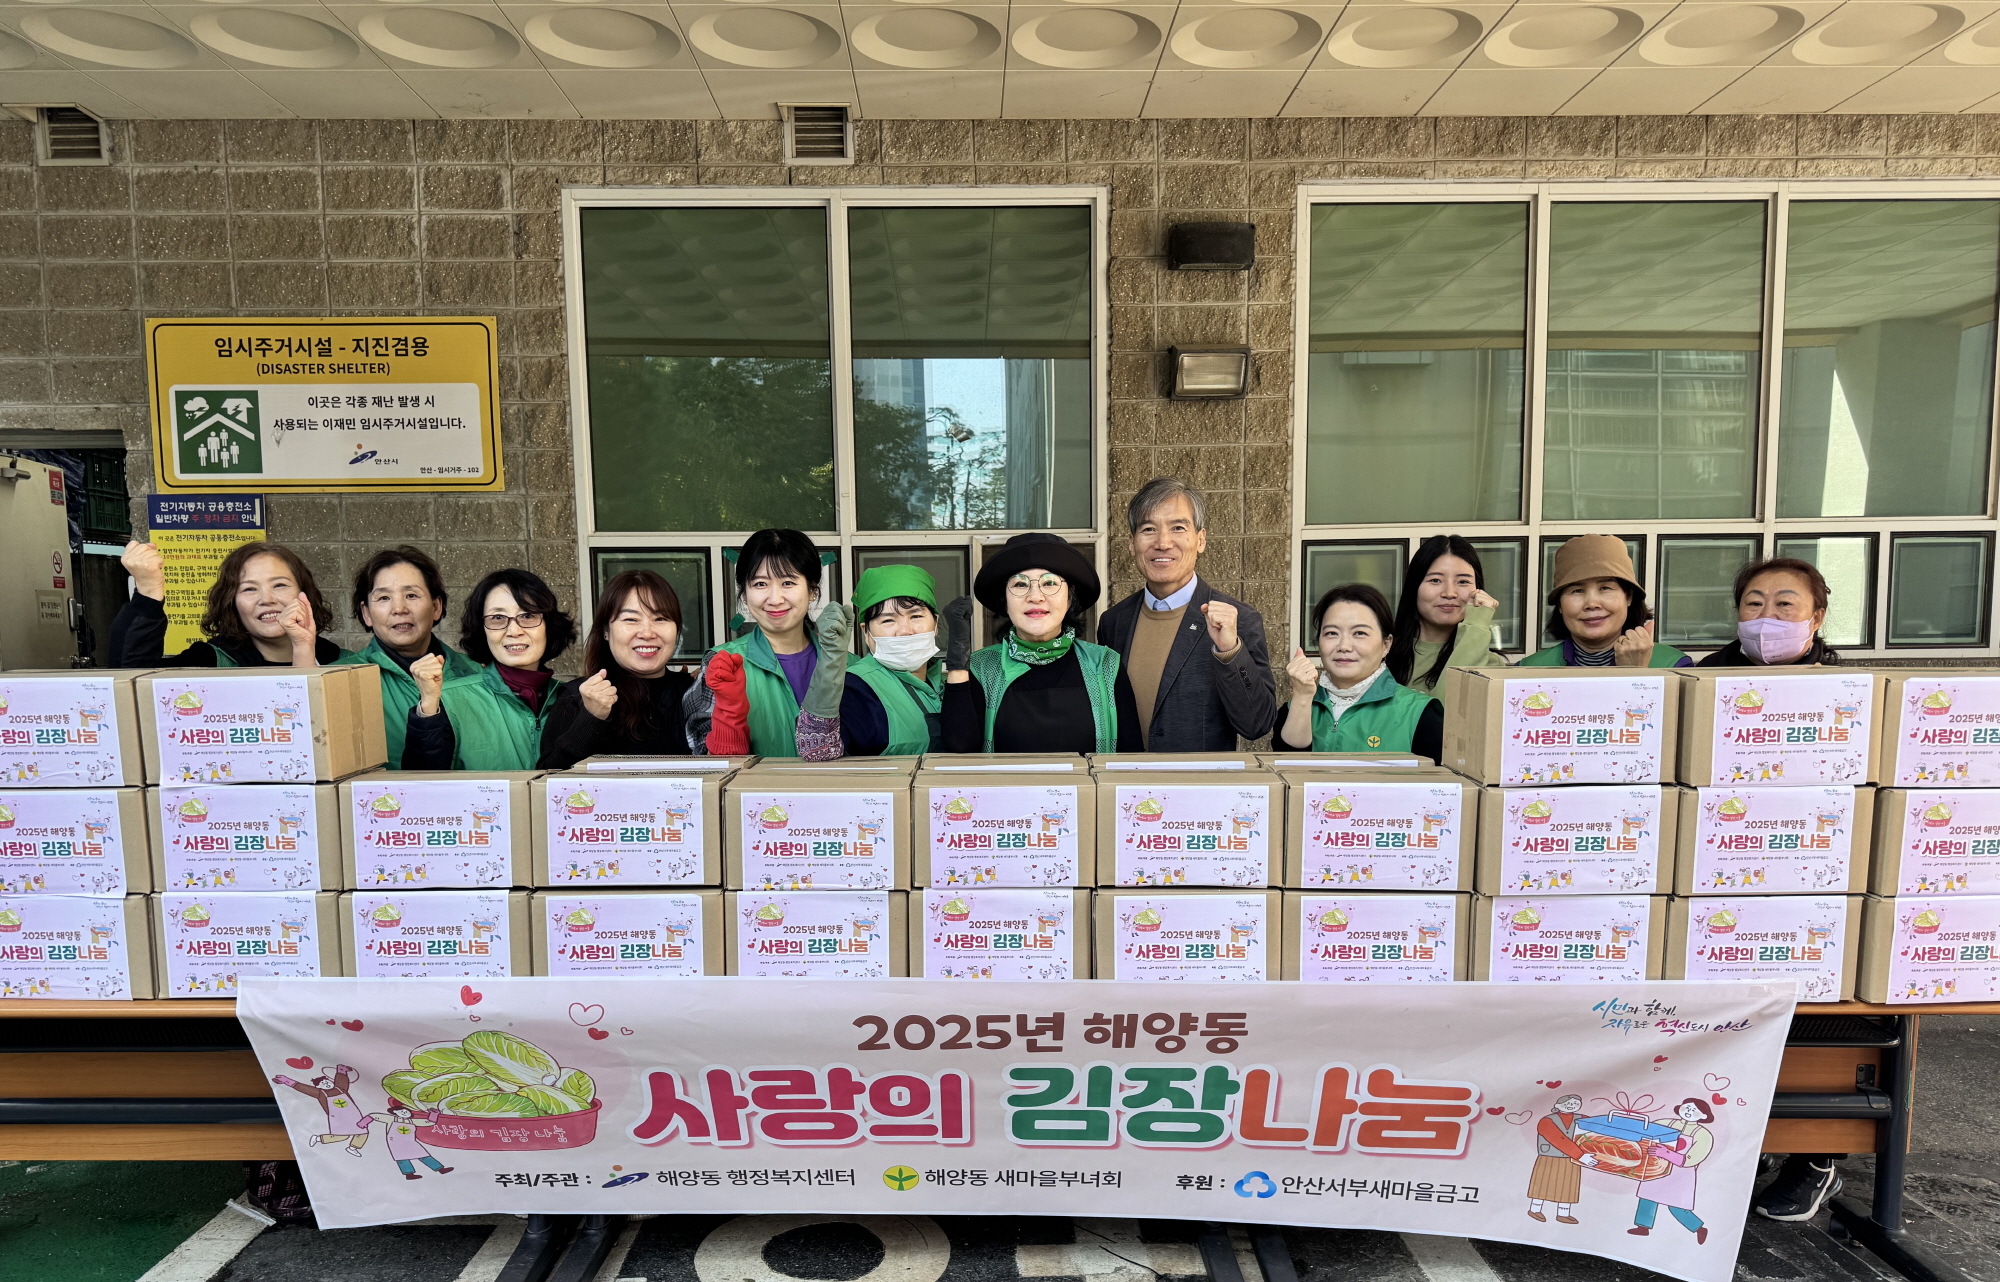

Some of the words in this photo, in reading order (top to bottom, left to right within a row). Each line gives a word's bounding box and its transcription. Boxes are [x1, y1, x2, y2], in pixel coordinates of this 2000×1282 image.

[214, 336, 333, 358] 임시주거시설
[352, 336, 430, 358] 지진겸용
[256, 362, 325, 376] (DISASTER
[328, 362, 390, 376] SHELTER)
[308, 396, 341, 408] 이곳은
[345, 396, 368, 408] 각종
[372, 396, 394, 408] 재난
[398, 395, 420, 408] 발생
[425, 395, 435, 408] 시
[273, 418, 319, 431] 사용되는
[322, 418, 356, 430] 이재민
[360, 417, 466, 430] 임시주거시설입니다.
[160, 502, 205, 512] 전기자동차
[208, 502, 252, 511] 공용충전소
[155, 514, 189, 523] 일반차량
[223, 514, 239, 523] 금지
[9, 715, 42, 724] 2025년
[44, 714, 71, 724] 해양동
[203, 714, 236, 723] 2025년
[238, 714, 264, 723] 해양동
[1551, 715, 1585, 725] 2025년
[1588, 714, 1615, 725] 해양동
[1762, 713, 1795, 722] 2025년
[1798, 712, 1824, 722] 해양동
[36, 729, 97, 744] 김장나눔
[180, 728, 225, 744] 사랑의
[229, 728, 291, 743] 김장나눔
[1525, 729, 1572, 745] 사랑의
[1577, 728, 1641, 744] 김장나눔
[1736, 728, 1782, 743] 사랑의
[1786, 726, 1850, 742] 김장나눔
[400, 817, 434, 826] 2025년
[436, 816, 463, 826] 해양동
[594, 813, 627, 823] 2025년
[630, 813, 656, 823] 해양동
[972, 820, 1005, 829] 2025년
[1007, 819, 1032, 829] 해양동
[1351, 818, 1384, 828] 2025년
[1386, 819, 1413, 829] 해양동
[1744, 820, 1778, 830] 2025년
[1780, 820, 1807, 830] 해양동
[16, 828, 48, 837] 2025년
[50, 827, 76, 837] 해양동
[208, 822, 241, 831] 2025년
[244, 821, 270, 831] 해양동
[788, 828, 820, 837] 2025년
[823, 828, 848, 837] 해양동
[1161, 821, 1195, 830] 2025년
[1197, 821, 1223, 831] 해양동
[1550, 823, 1584, 832] 2025년
[1586, 822, 1612, 832] 해양동
[376, 830, 422, 846] 사랑의
[426, 830, 489, 845] 김장나눔
[569, 827, 615, 842] 사랑의
[620, 827, 682, 842] 김장나눔
[948, 833, 992, 848] 사랑의
[997, 833, 1057, 848] 김장나눔
[1324, 831, 1370, 847] 사랑의
[1376, 832, 1438, 847] 김장나눔
[1718, 834, 1764, 849] 사랑의
[1768, 834, 1831, 849] 김장나눔
[42, 841, 102, 856] 김장나눔
[184, 835, 229, 850] 사랑의
[234, 835, 296, 850] 김장나눔
[763, 841, 808, 856] 사랑의
[813, 841, 873, 856] 김장나눔
[1137, 834, 1182, 849] 사랑의
[1186, 835, 1248, 850] 김장나눔
[1524, 836, 1570, 852] 사랑의
[1574, 836, 1637, 851] 김장나눔
[210, 926, 243, 936] 2025년
[246, 926, 272, 936] 해양동
[401, 926, 434, 936] 2025년
[436, 926, 463, 936] 해양동
[783, 925, 816, 934] 2025년
[818, 925, 844, 935] 해양동
[969, 920, 1001, 929] 2025년
[1003, 920, 1029, 930] 해양동
[22, 932, 54, 941] 2025년
[56, 932, 82, 941] 해양동
[594, 931, 628, 940] 2025년
[630, 930, 656, 940] 해양동
[944, 933, 989, 948] 사랑의
[993, 934, 1053, 948] 김장나눔
[1160, 931, 1193, 940] 2025년
[1195, 930, 1221, 940] 해양동
[1347, 931, 1380, 940] 2025년
[1382, 931, 1409, 941] 해양동
[1539, 930, 1573, 940] 2025년
[1575, 930, 1602, 940] 해양동
[1734, 932, 1768, 942] 2025년
[1771, 932, 1797, 942] 해양동
[1938, 932, 1970, 941] 2025년
[1972, 931, 1997, 941] 해양동
[0, 945, 43, 960] 사랑의
[47, 945, 108, 960] 김장나눔
[187, 940, 232, 955] 사랑의
[236, 940, 298, 955] 김장나눔
[376, 940, 423, 955] 사랑의
[427, 940, 489, 955] 김장나눔
[570, 944, 616, 960] 사랑의
[620, 943, 682, 958] 김장나눔
[759, 939, 803, 954] 사랑의
[808, 938, 868, 953] 김장나눔
[1136, 944, 1181, 959] 사랑의
[1185, 944, 1246, 958] 김장나눔
[1322, 944, 1367, 959] 사랑의
[1372, 944, 1433, 959] 김장나눔
[1512, 943, 1559, 958] 사랑의
[1564, 944, 1626, 959] 김장나눔
[1708, 946, 1754, 961] 사랑의
[1759, 946, 1822, 961] 김장나눔
[1912, 946, 1956, 961] 사랑의
[851, 1012, 1067, 1054] 2025년
[1082, 1011, 1249, 1054] 해양동
[631, 1066, 963, 1145] 사랑의
[1005, 1064, 1474, 1152] 김장나눔
[431, 1124, 485, 1140] 사랑의
[490, 1126, 530, 1143] 김장
[534, 1125, 568, 1143] 나눔
[494, 1172, 579, 1187] 주최/주관
[656, 1170, 722, 1186] 해양동
[726, 1168, 855, 1186] 행정복지센터
[925, 1168, 989, 1186] 해양동
[994, 1169, 1122, 1188] 새마을부녀회
[1176, 1175, 1213, 1191] 후원
[1281, 1175, 1481, 1204] 안산서부새마을금고
